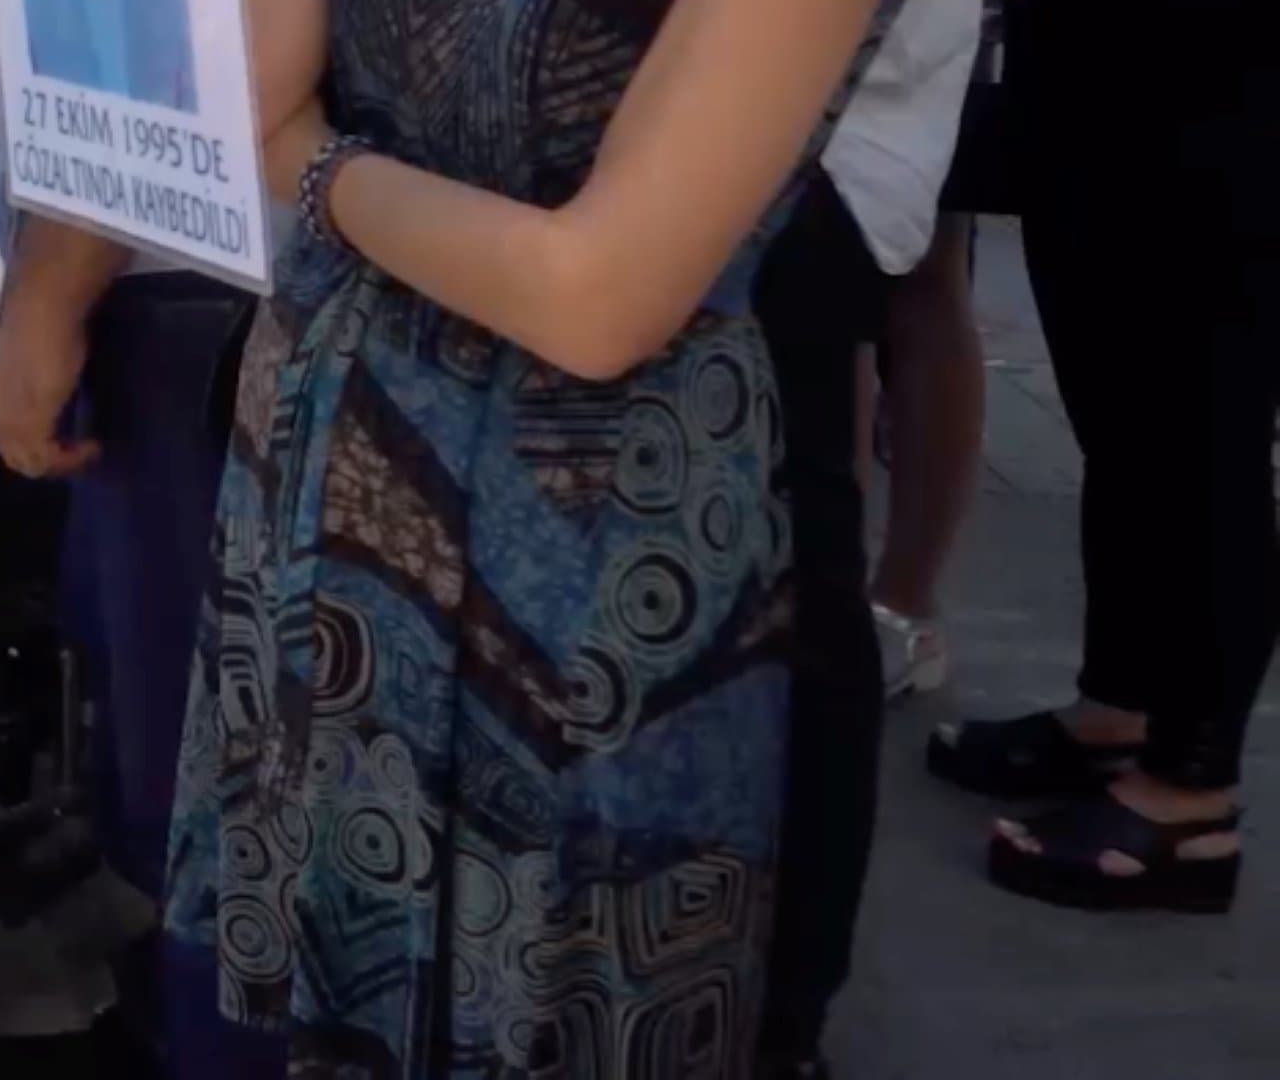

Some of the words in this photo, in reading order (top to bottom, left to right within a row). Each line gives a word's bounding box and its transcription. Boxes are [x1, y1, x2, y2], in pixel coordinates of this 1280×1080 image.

[22, 88, 47, 129] 27
[55, 92, 114, 149] EKİM
[13, 132, 129, 219] GÖZALTINDA
[131, 175, 252, 259] KAYBEDİLDİ
